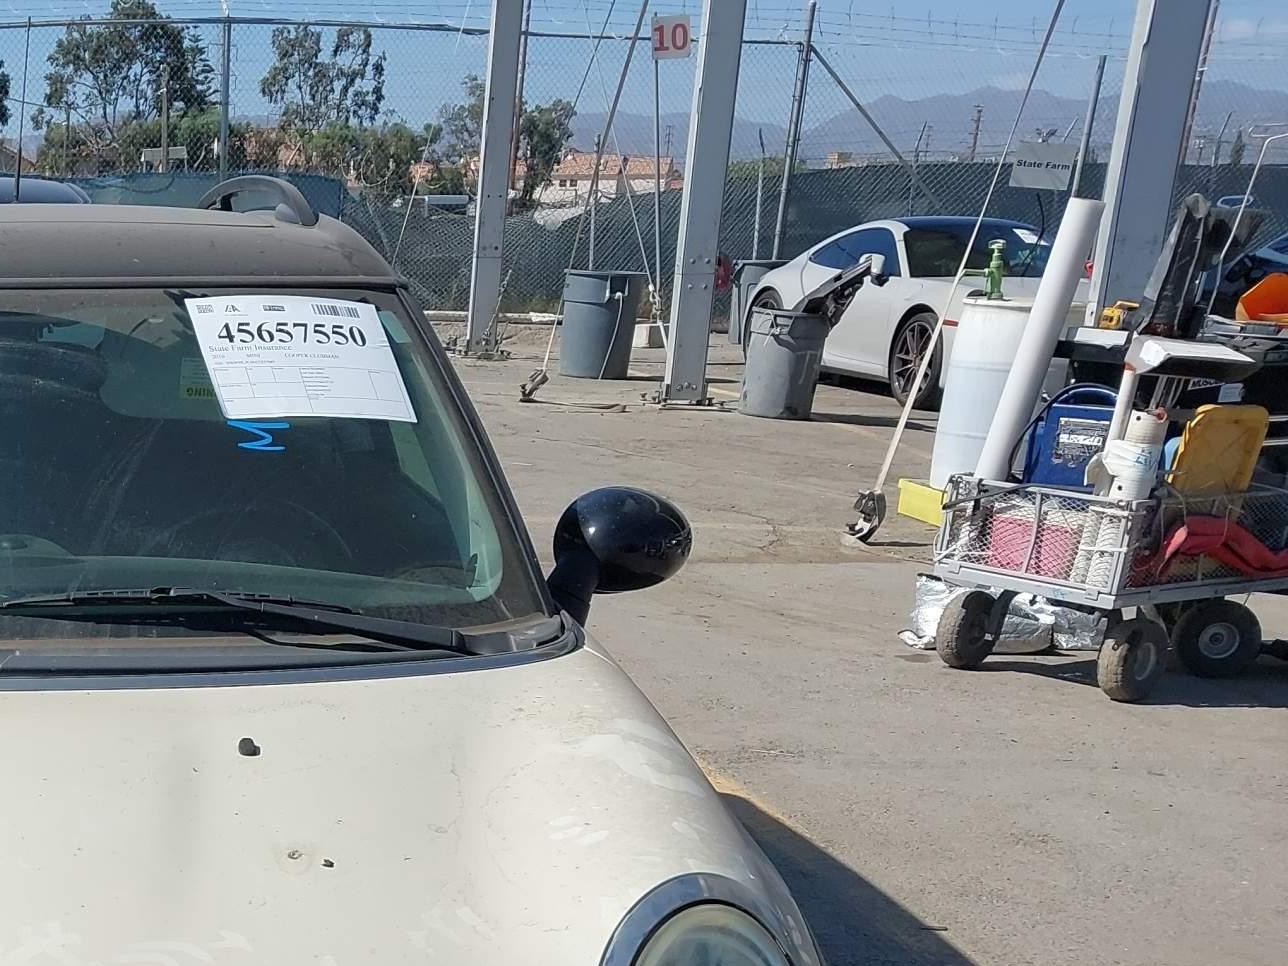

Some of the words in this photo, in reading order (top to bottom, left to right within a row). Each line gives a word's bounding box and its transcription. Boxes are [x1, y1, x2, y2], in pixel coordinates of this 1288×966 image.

[654, 23, 688, 51] 10
[1016, 160, 1043, 168] State
[1045, 161, 1071, 170] Farm
[217, 321, 367, 347] 45657550
[254, 344, 292, 352] Insurance
